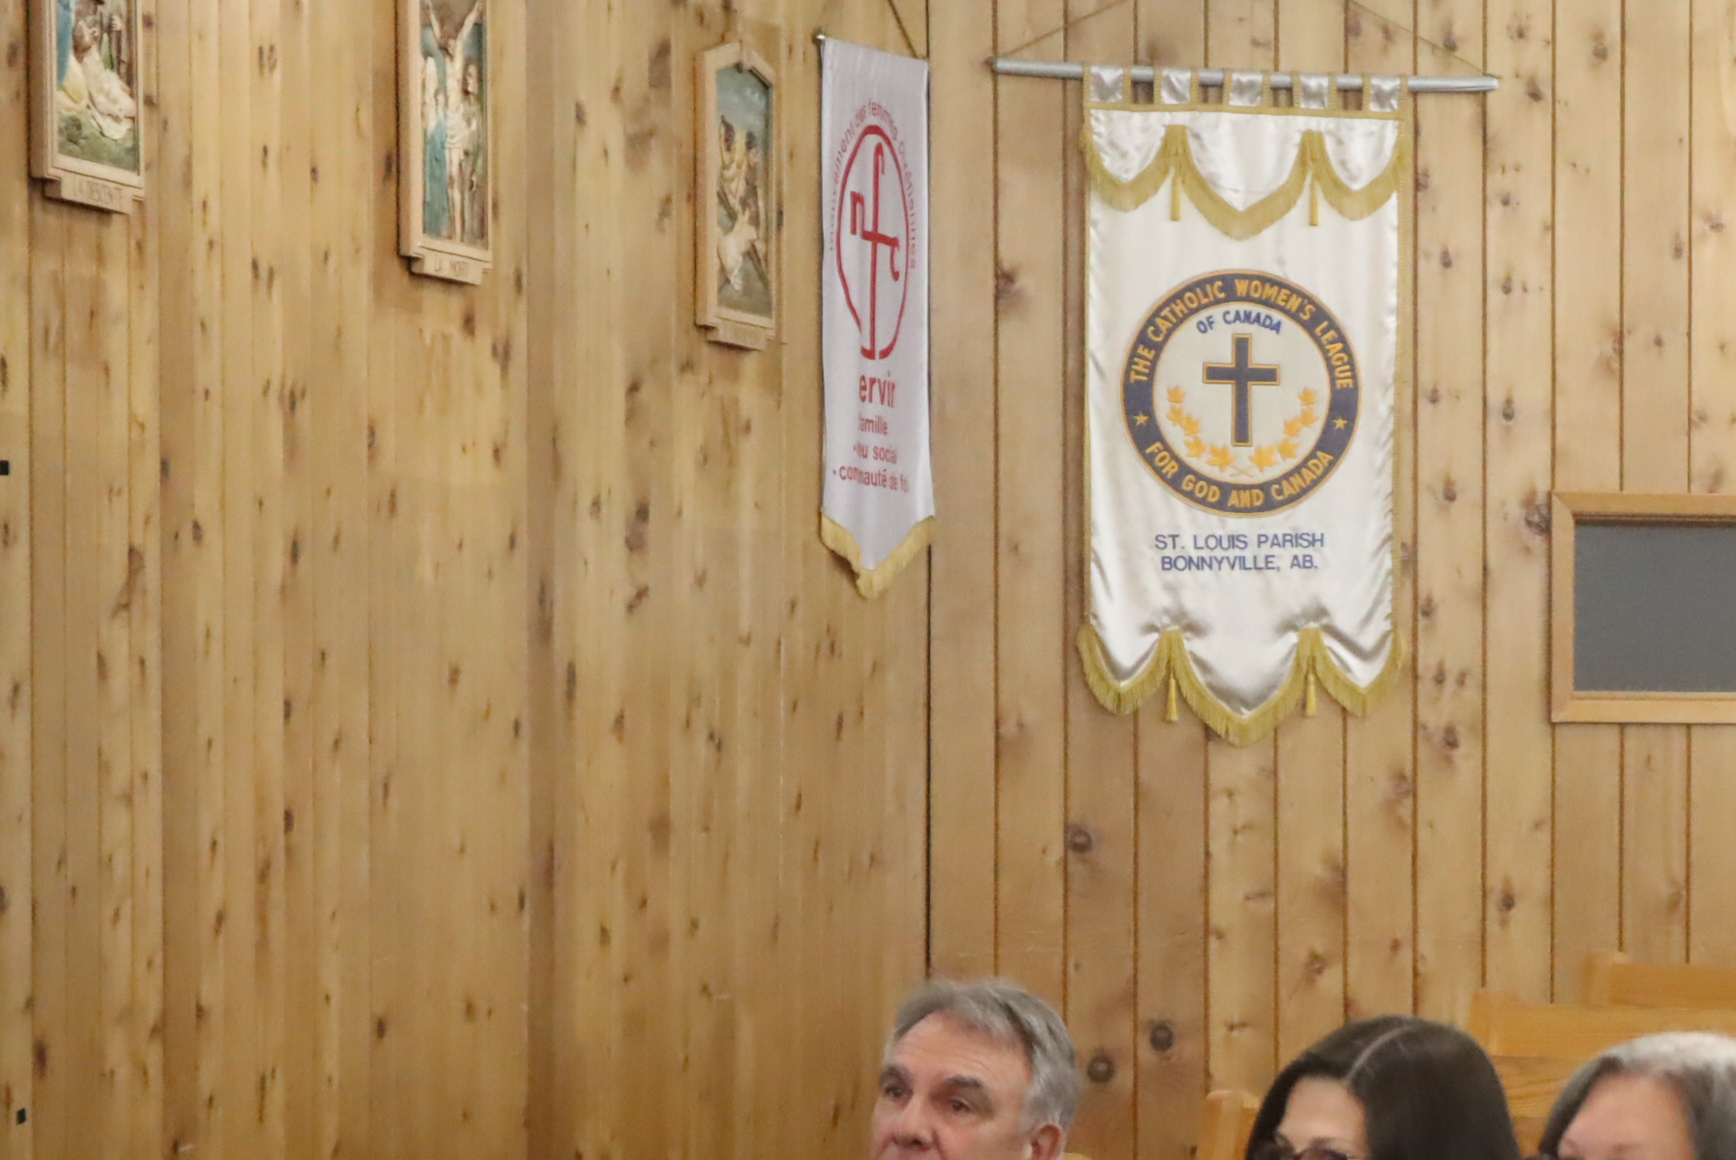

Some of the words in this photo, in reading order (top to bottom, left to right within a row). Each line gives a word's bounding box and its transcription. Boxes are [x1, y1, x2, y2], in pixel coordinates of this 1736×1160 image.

[1130, 344, 1155, 384] THE
[1147, 279, 1226, 343] CATHOLIC
[1234, 278, 1316, 322] WOMEN'S
[1314, 320, 1354, 390] LEAGUE
[1196, 315, 1216, 335] OF
[1222, 309, 1283, 335] CANADA
[1145, 441, 1176, 479] FOR
[1181, 474, 1221, 504] GOD
[1227, 488, 1265, 509] AND
[1270, 450, 1334, 501] CANADA
[1154, 533, 1186, 551] ST.
[1193, 533, 1249, 551] LOUIS
[1256, 532, 1325, 549] PARISH
[1161, 554, 1281, 573] BONNYVILLE,
[1289, 554, 1319, 571] AB.
